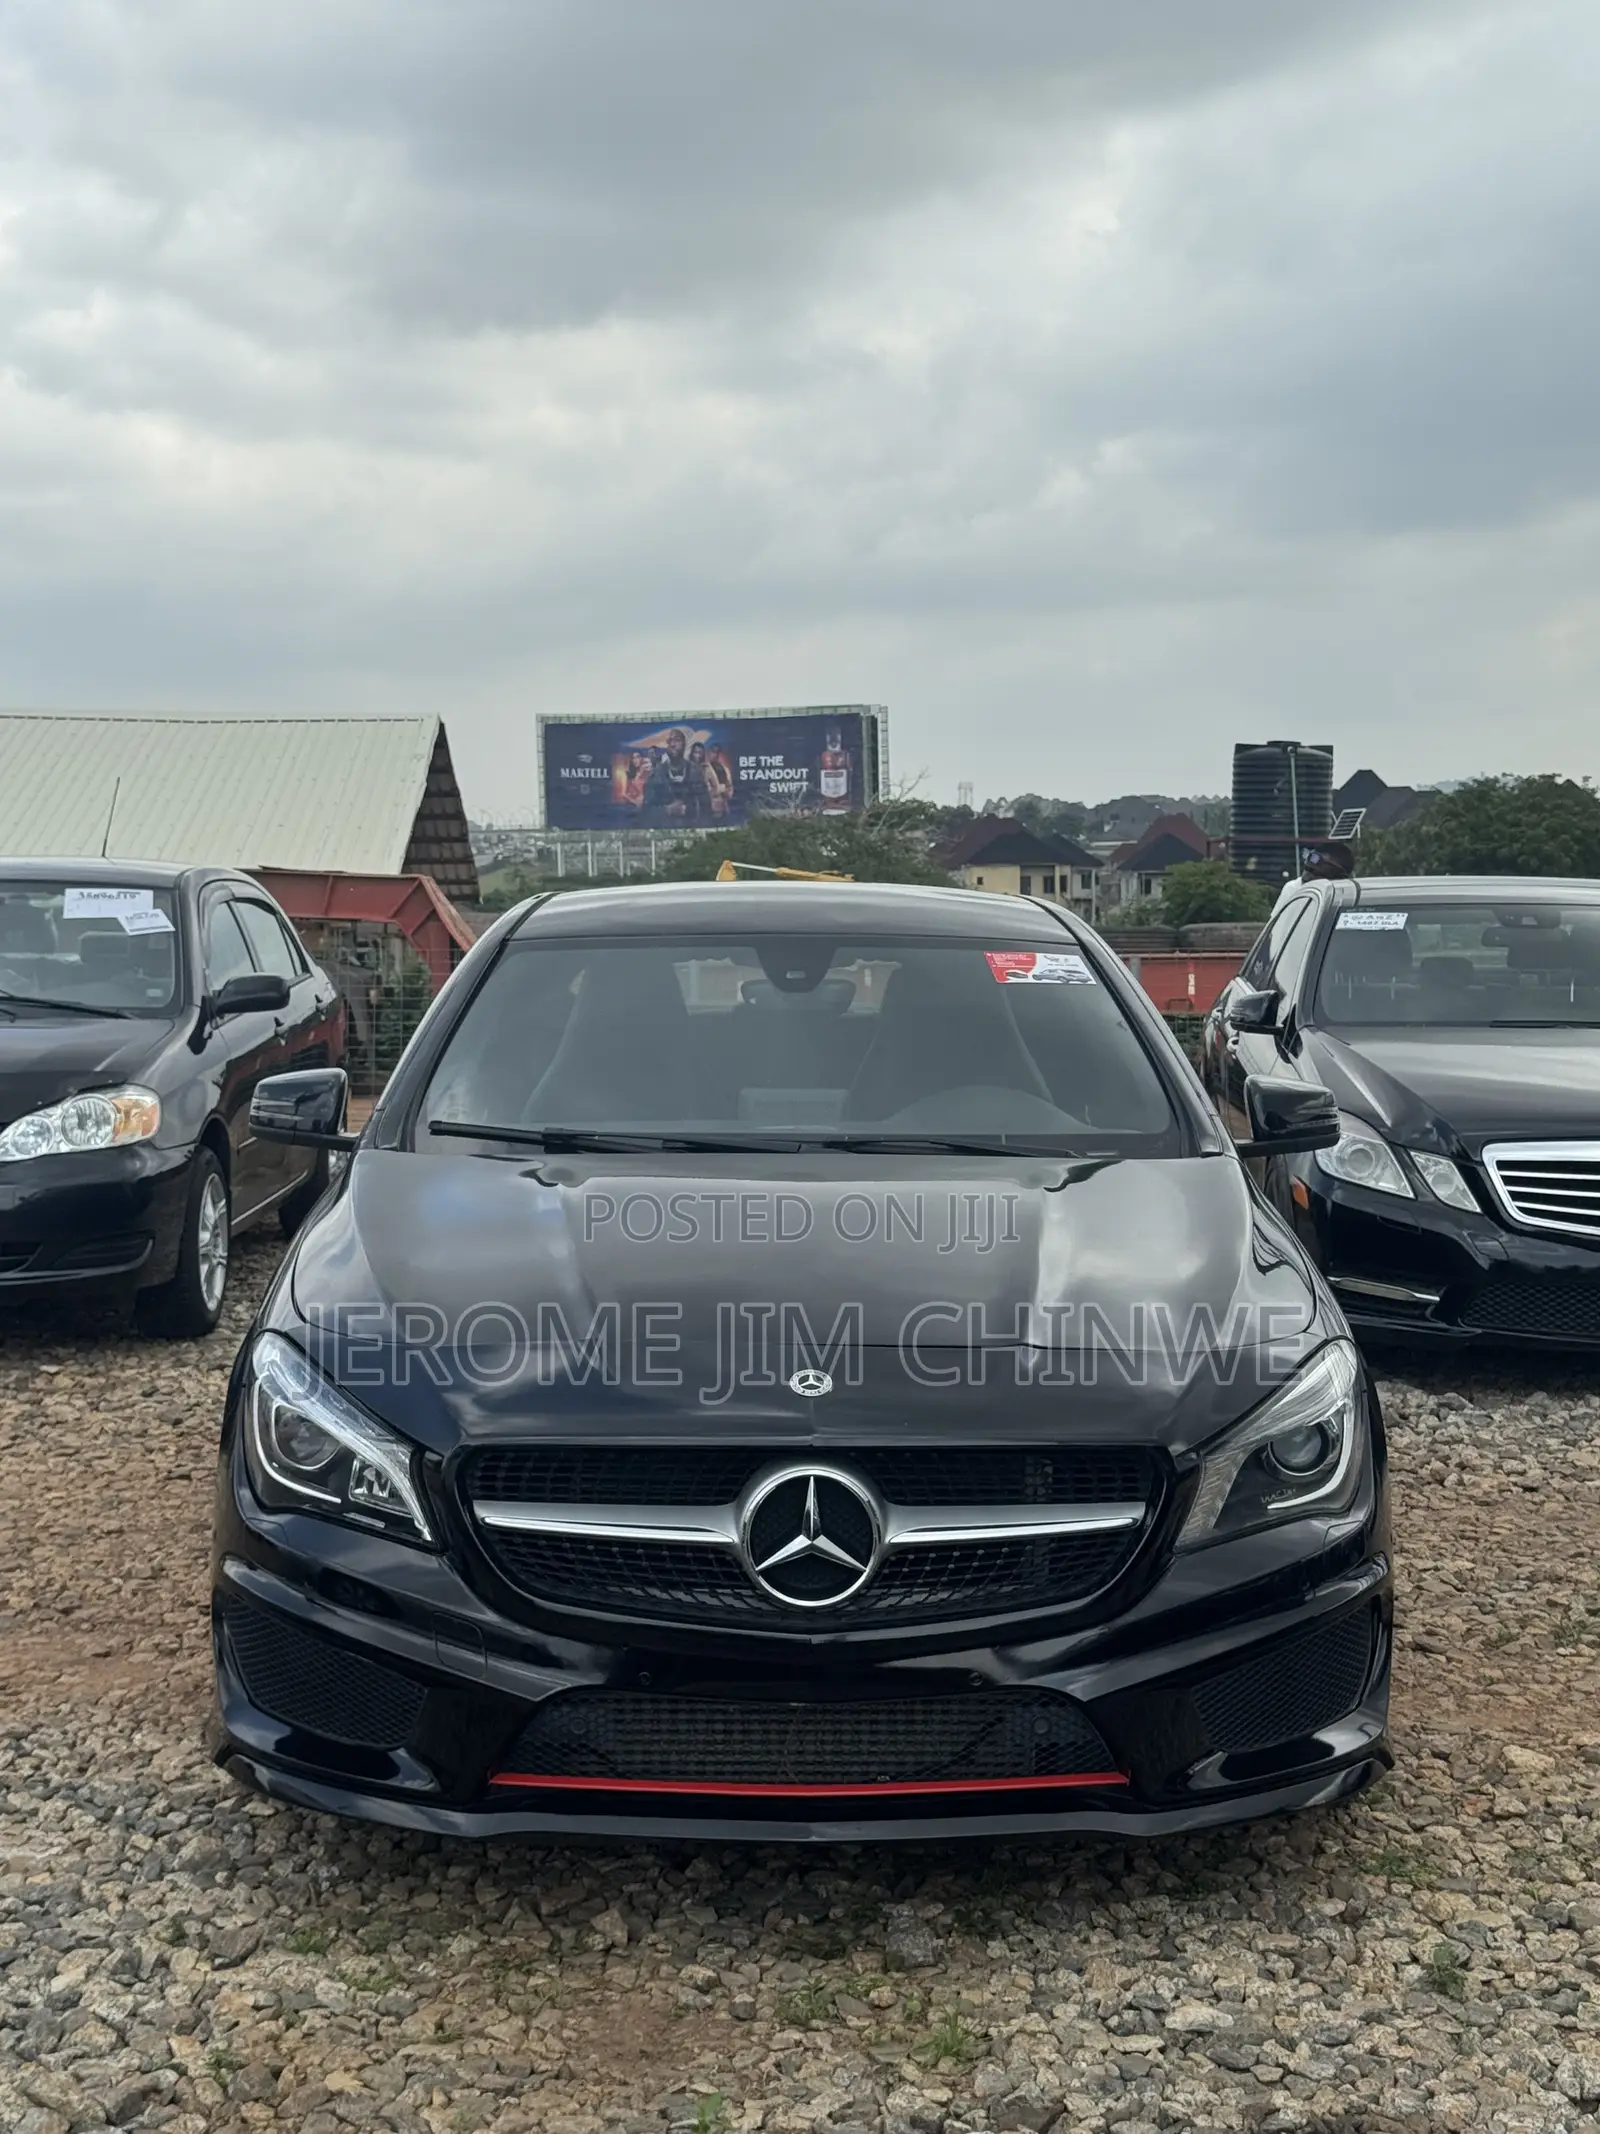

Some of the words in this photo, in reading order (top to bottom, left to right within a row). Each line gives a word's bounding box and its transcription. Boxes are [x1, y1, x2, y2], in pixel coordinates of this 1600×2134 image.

[739, 756, 757, 767] BE
[759, 755, 784, 766] THE
[560, 767, 610, 779] MARTELL
[740, 768, 809, 780] STANDOUT
[769, 782, 809, 794] SWIFT
